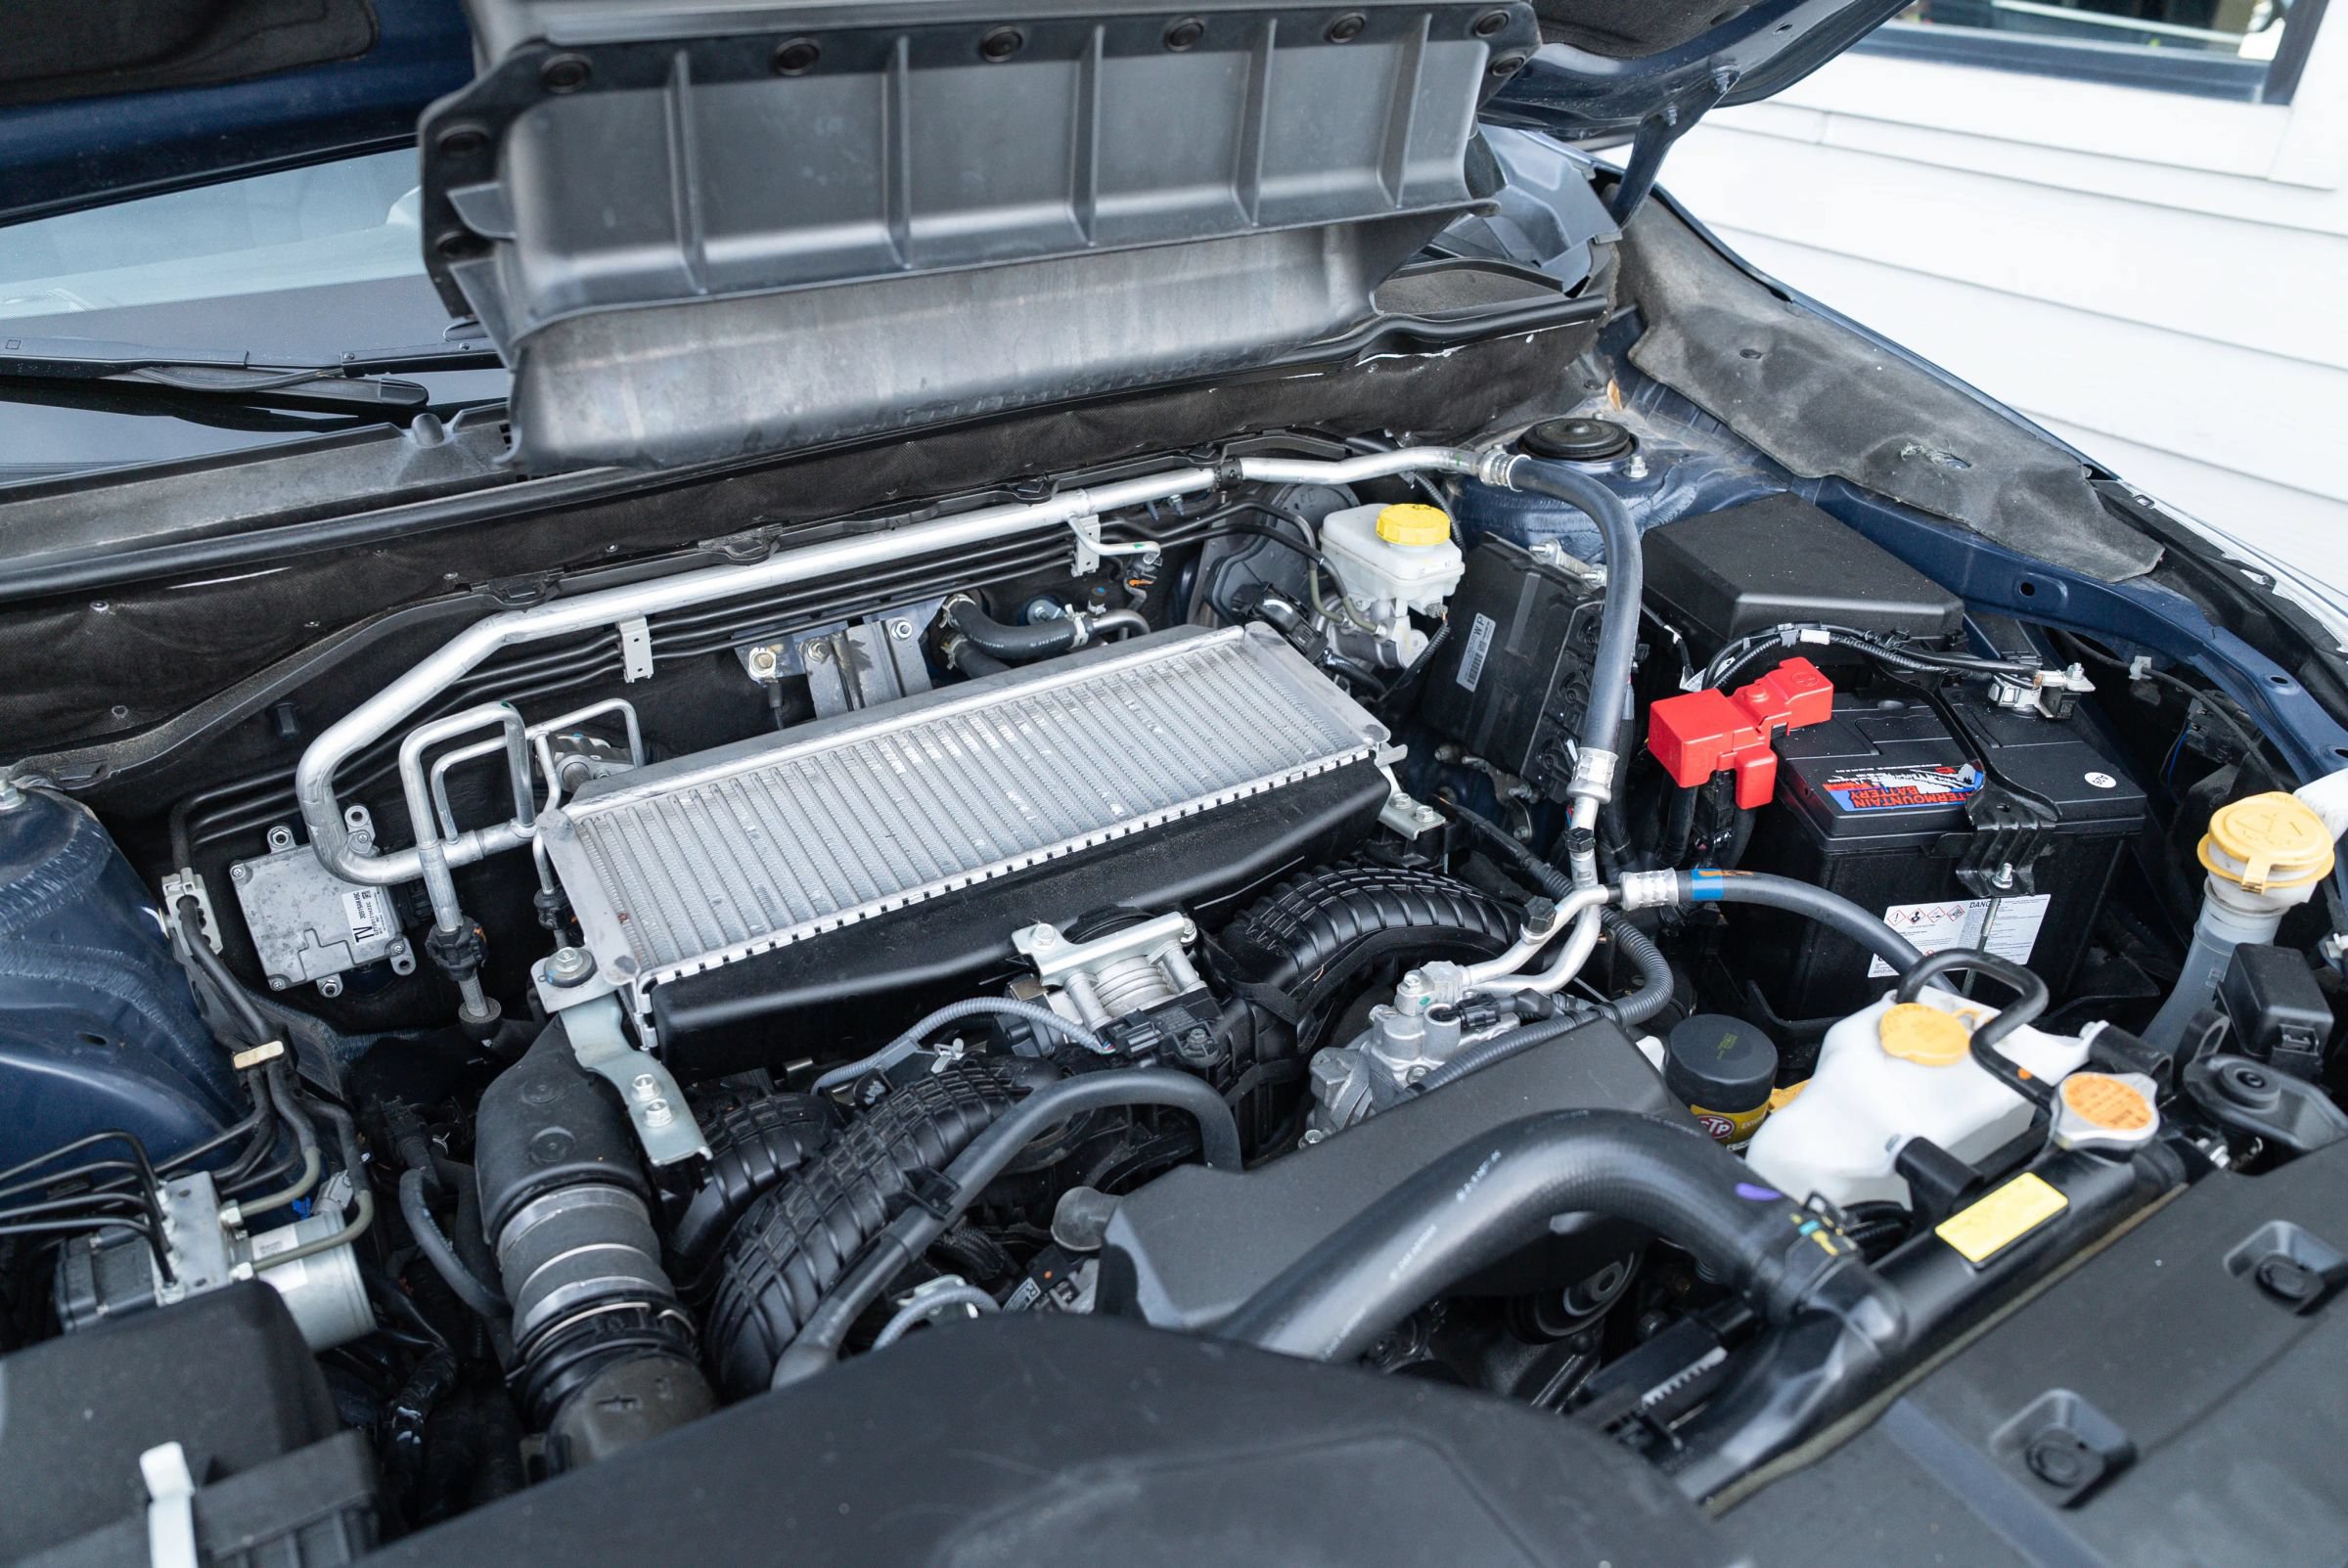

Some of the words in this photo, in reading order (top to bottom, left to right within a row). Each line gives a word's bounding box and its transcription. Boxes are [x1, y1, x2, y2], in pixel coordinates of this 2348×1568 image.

[1850, 785, 1919, 800] BATTERY
[1854, 791, 1972, 809] TERMOUNTAIN
[1969, 899, 2001, 909] DANG
[353, 926, 375, 943] TV
